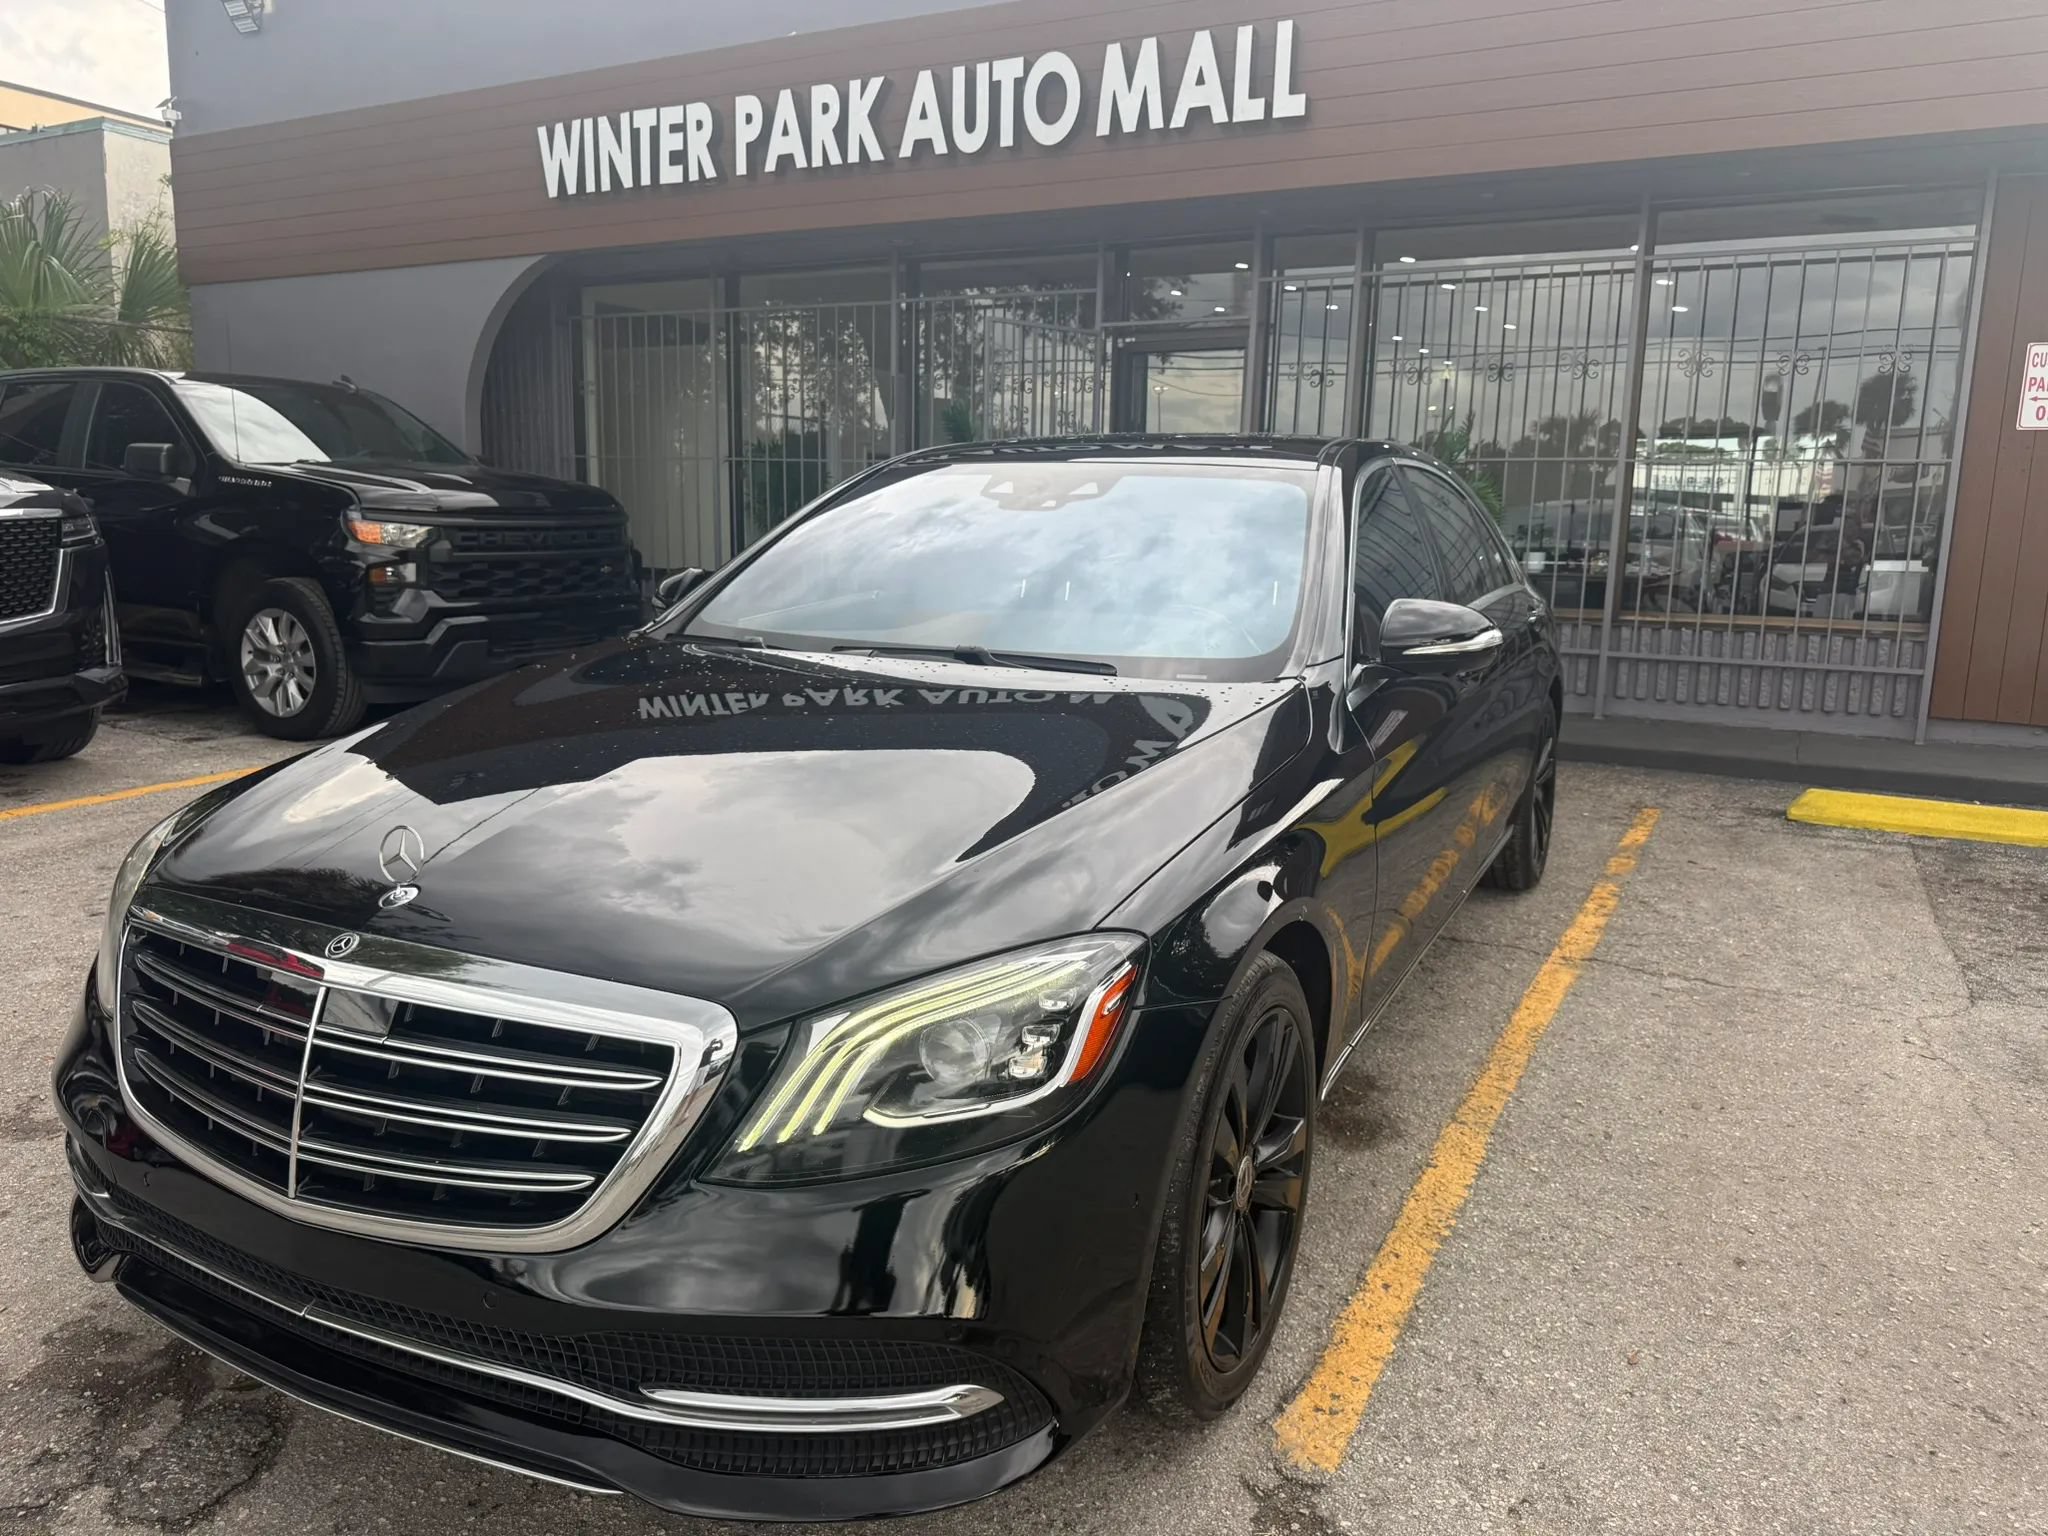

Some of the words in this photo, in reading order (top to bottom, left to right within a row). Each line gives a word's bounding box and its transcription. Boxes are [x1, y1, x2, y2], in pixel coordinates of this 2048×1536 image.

[538, 103, 717, 198] WINTER
[735, 76, 885, 176] PARK
[899, 52, 1081, 159] AUTO
[1096, 20, 1306, 137] MALL
[2031, 352, 2048, 368] CU
[2028, 376, 2048, 392] PA
[2035, 405, 2048, 421] O
[456, 529, 618, 546] CHEVOLE
